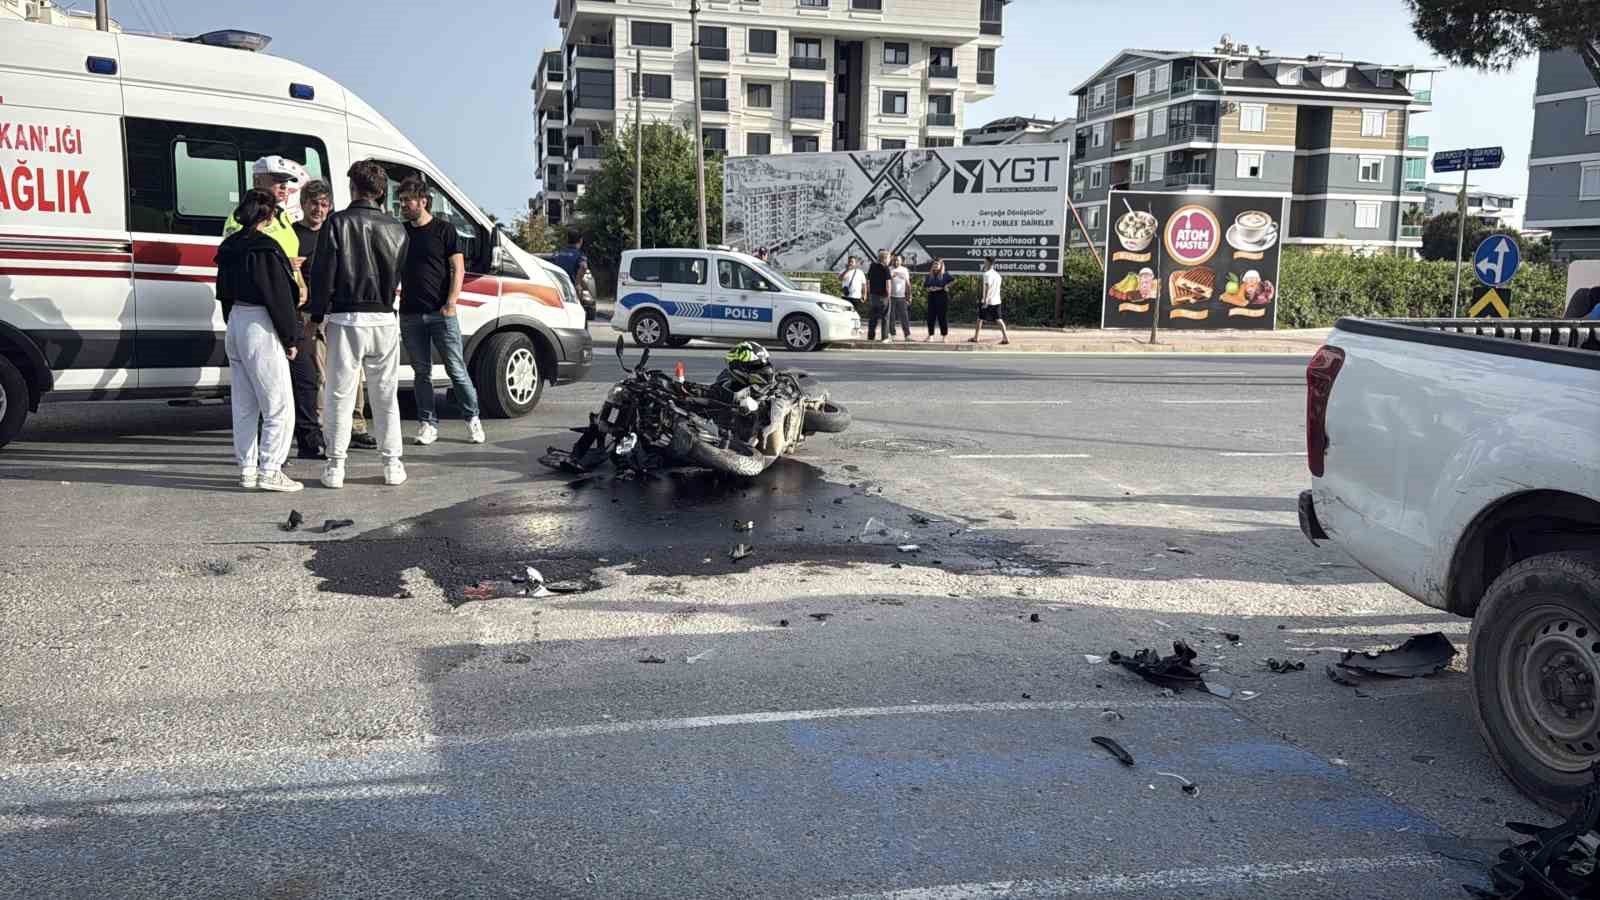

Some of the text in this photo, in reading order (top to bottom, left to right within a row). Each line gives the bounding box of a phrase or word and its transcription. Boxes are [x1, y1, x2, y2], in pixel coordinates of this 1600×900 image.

[987, 157, 1060, 183] YGT
[1176, 229, 1209, 241] ATOM
[1175, 240, 1209, 250] MASTER
